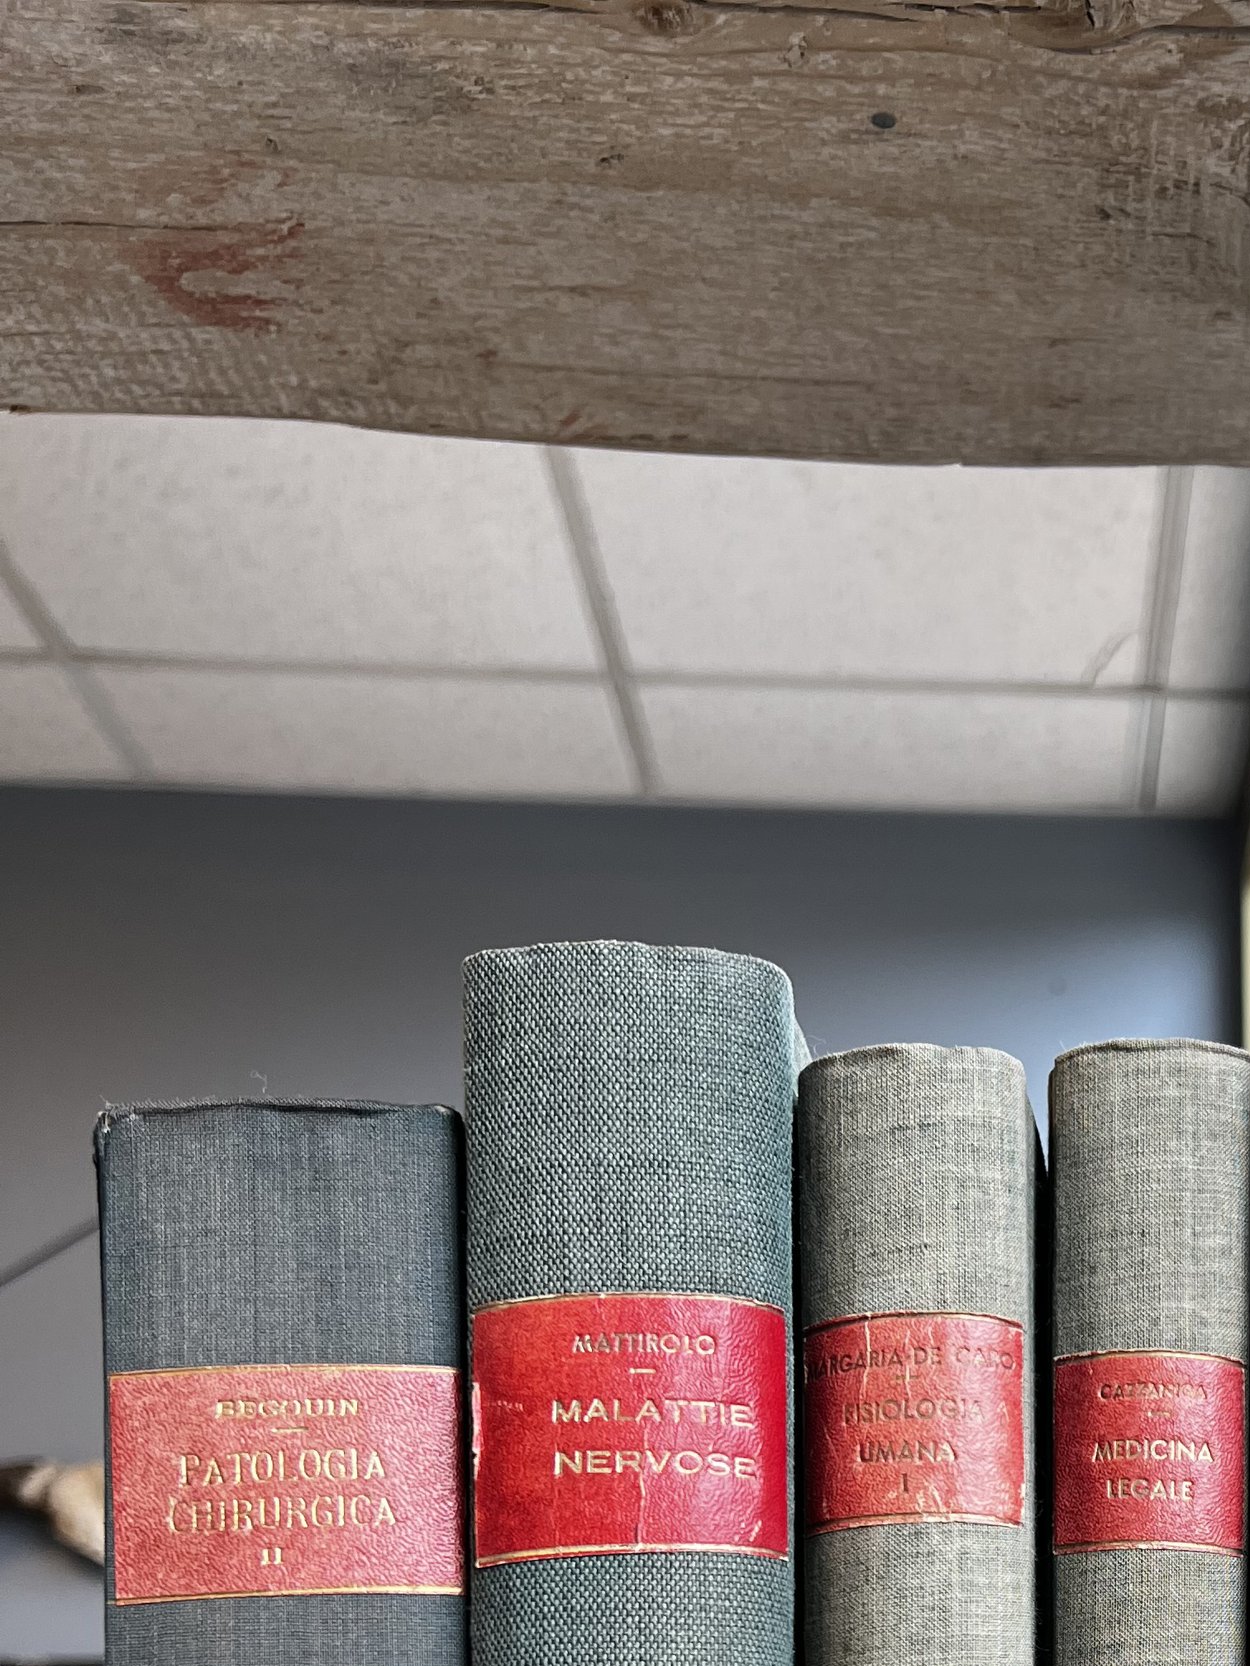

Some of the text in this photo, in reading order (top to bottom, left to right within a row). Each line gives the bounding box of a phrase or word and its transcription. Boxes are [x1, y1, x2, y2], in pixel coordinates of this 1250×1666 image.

[572, 1333, 717, 1355] MATTIROLO
[552, 1398, 753, 1428] MALATTIE
[843, 1399, 985, 1424] FISIOLOGIA
[858, 1440, 958, 1463] UMANA
[1091, 1438, 1215, 1462] MEDICINA
[178, 1449, 386, 1488] PATOLOGIA
[553, 1450, 757, 1479] NERVOSE
[1106, 1478, 1195, 1500] LEGALE
[167, 1495, 396, 1535] CHIRURGICA
[260, 1547, 283, 1565] II
